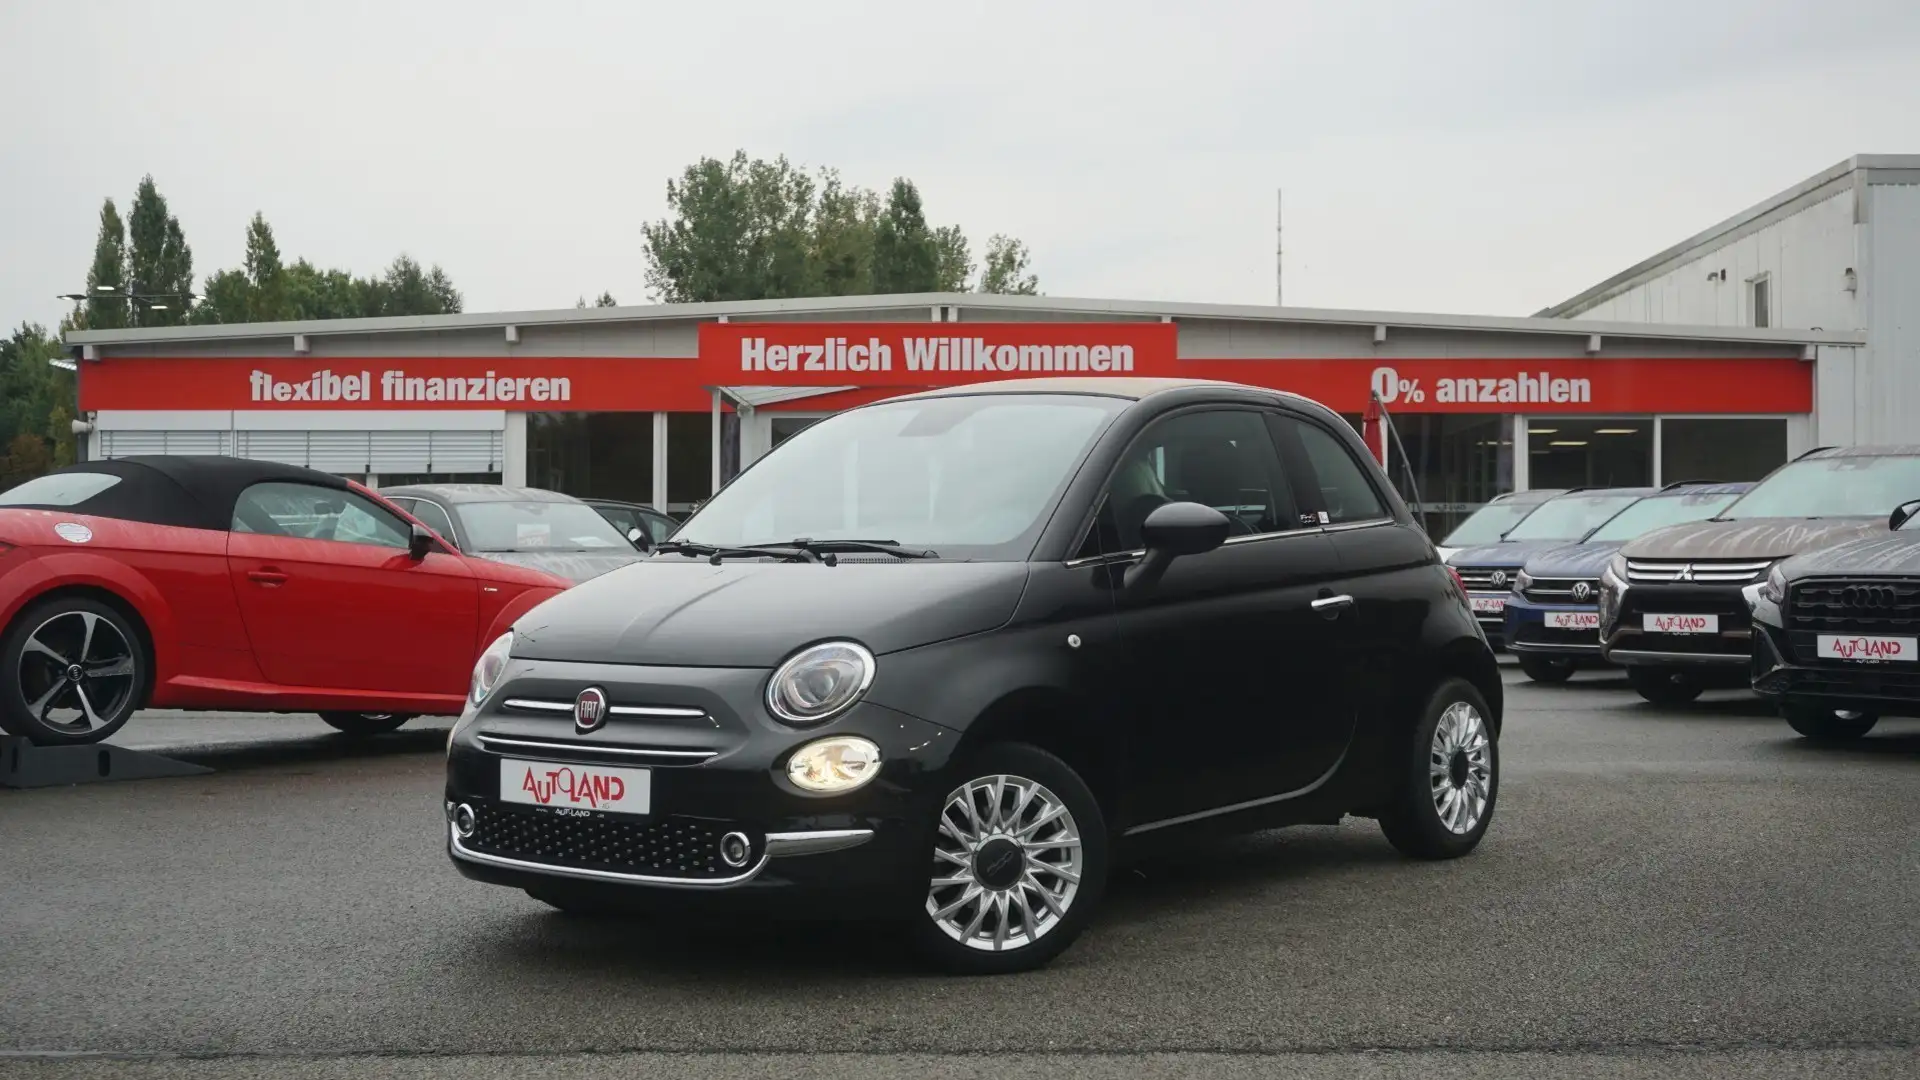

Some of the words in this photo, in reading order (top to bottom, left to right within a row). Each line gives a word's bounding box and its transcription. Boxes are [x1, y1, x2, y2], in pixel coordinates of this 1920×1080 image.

[741, 337, 892, 372] Herzlich
[903, 337, 1133, 372] Willkommen
[249, 369, 370, 401] flexibel
[381, 370, 571, 401] finanzieren
[1371, 366, 1425, 403] 0%
[1436, 372, 1591, 403] anzahlen
[1832, 637, 1902, 659] AUTOLAND
[580, 700, 598, 719] FIAT
[522, 765, 625, 809] AUTOLAND
